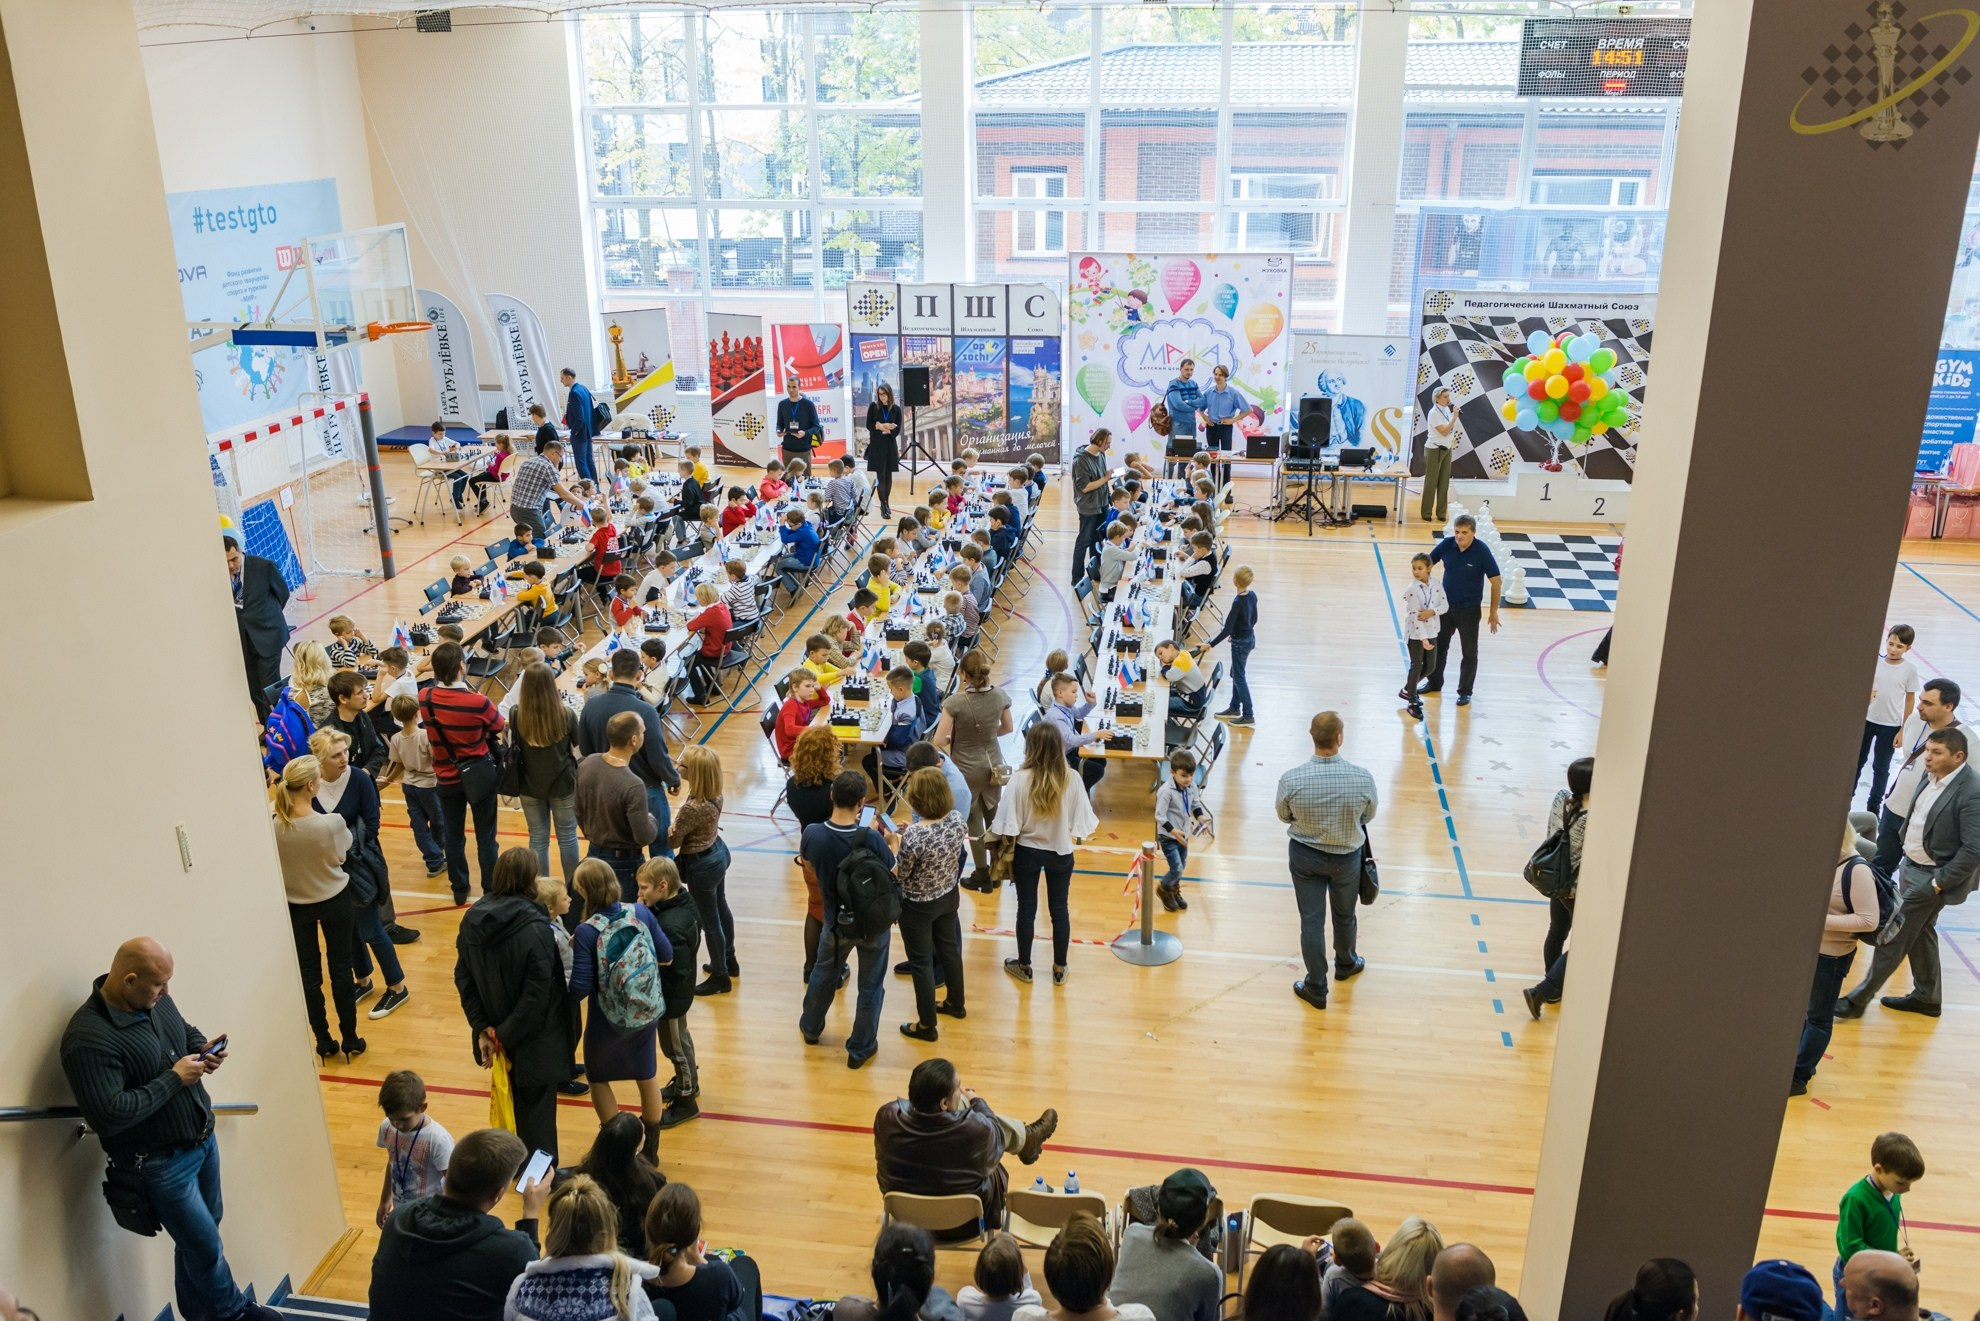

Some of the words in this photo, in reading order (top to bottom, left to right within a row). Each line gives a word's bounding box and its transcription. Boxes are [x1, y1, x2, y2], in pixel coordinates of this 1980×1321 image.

[1597, 39, 1644, 49] ВРЕМЯ
[1672, 41, 1690, 49] СЧ
[193, 203, 277, 234] #testgto
[914, 295, 939, 317] П
[964, 296, 997, 318] Ш
[1024, 295, 1045, 318] С
[1464, 300, 1546, 309] Педагогический
[1548, 301, 1608, 310] Шахматный
[1611, 303, 1640, 311] Союз
[863, 349, 887, 359] OPEN
[963, 353, 989, 361] sochi
[1301, 341, 1318, 355] 25
[437, 325, 456, 392] РУБЛЁВКЕ
[509, 325, 532, 393] РУБЛЁВКЕ
[1935, 359, 1974, 375] GYM
[448, 395, 459, 415] НА
[960, 431, 1034, 449] Организация,
[1540, 483, 1552, 501] 1
[1592, 497, 1605, 516] 2
